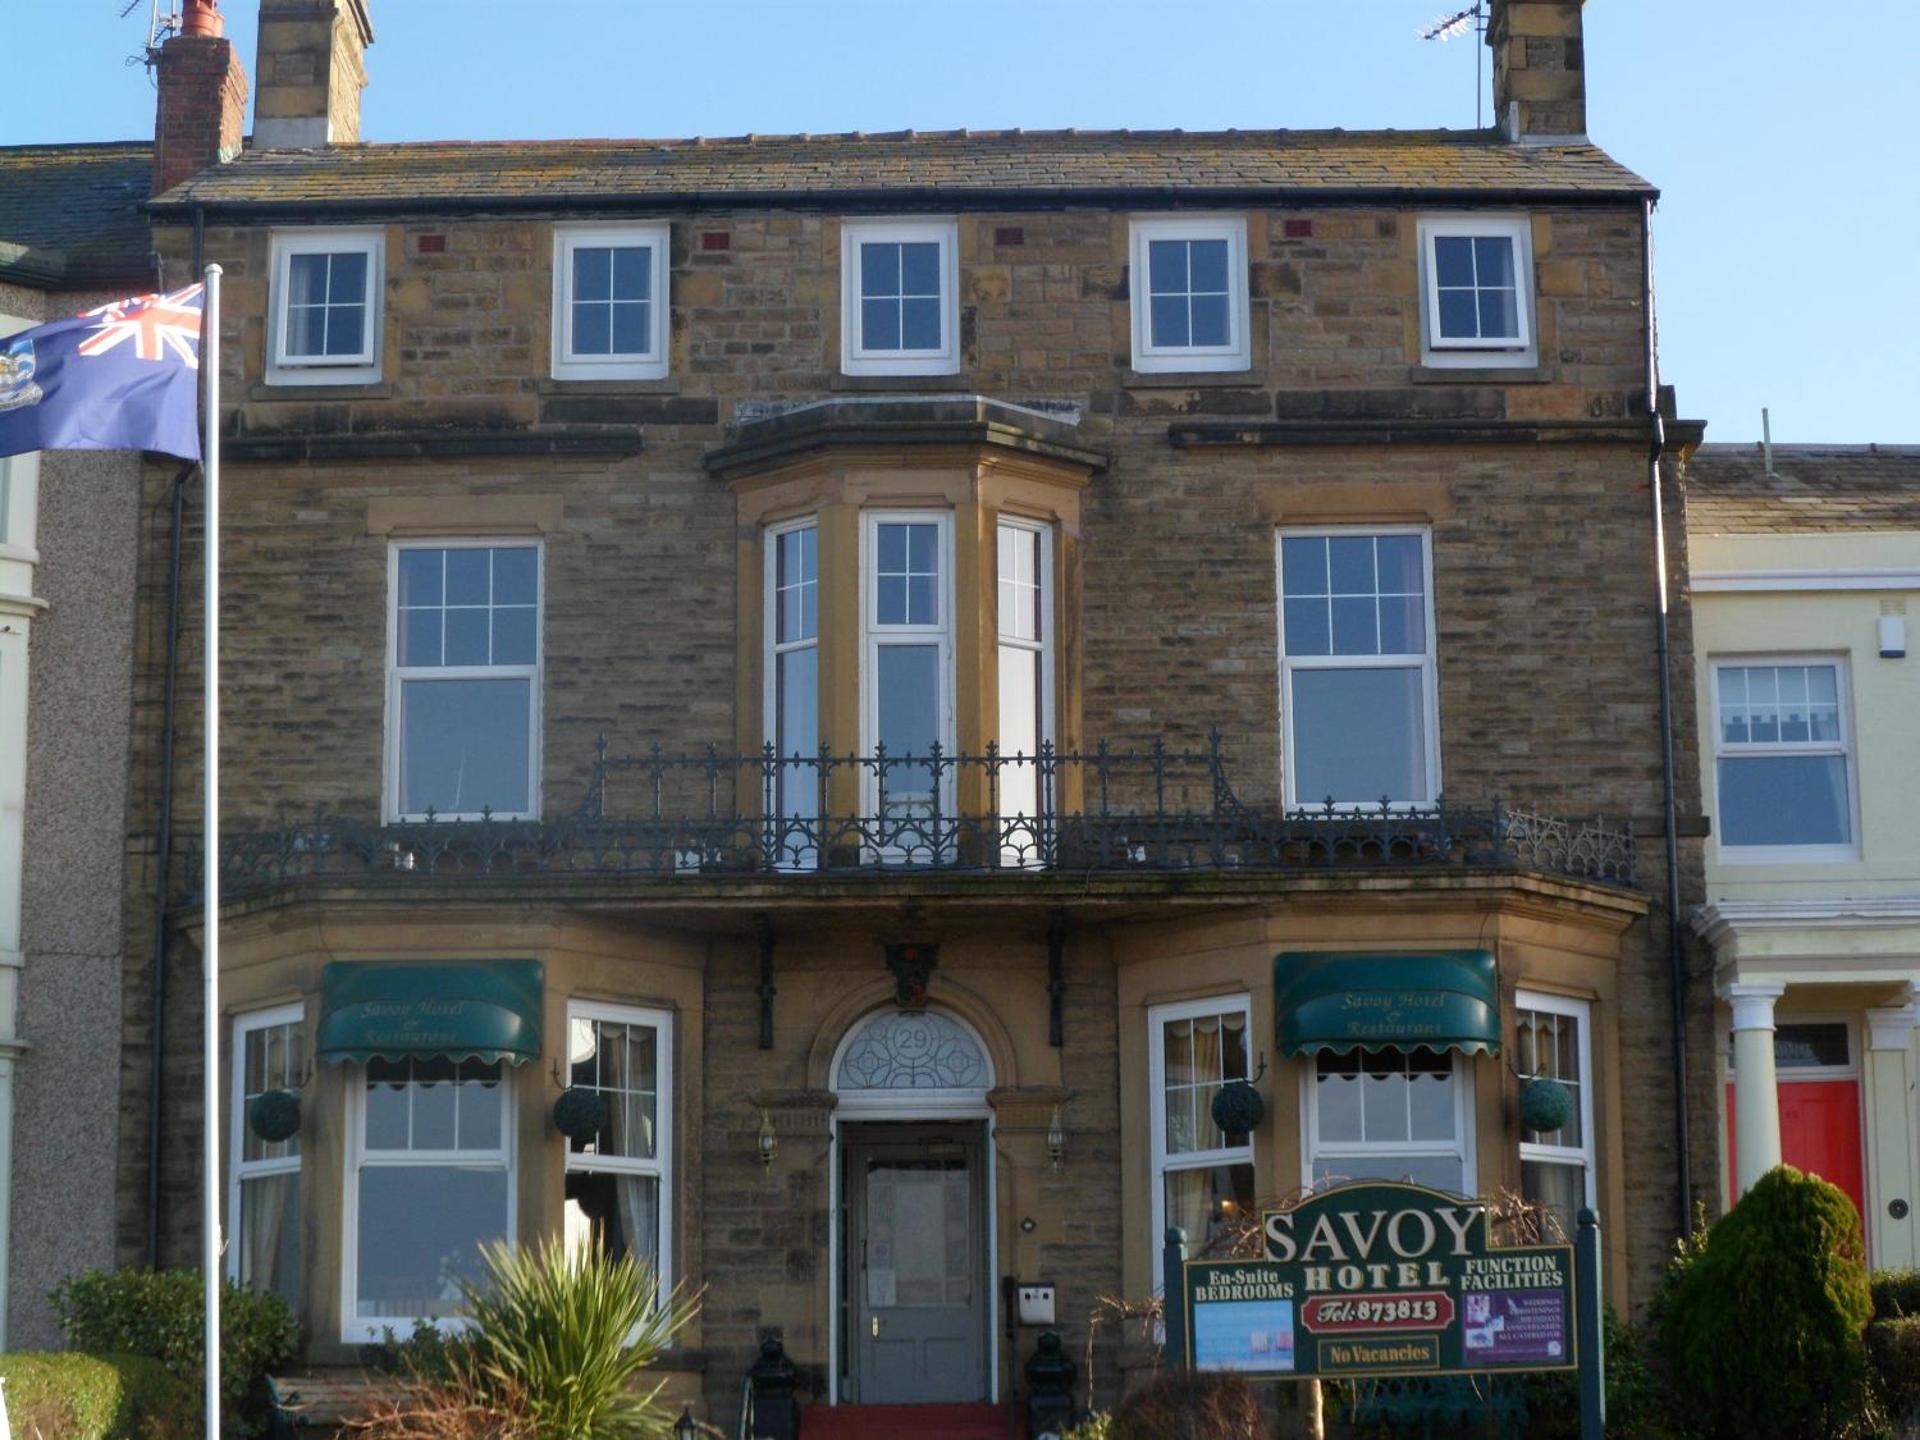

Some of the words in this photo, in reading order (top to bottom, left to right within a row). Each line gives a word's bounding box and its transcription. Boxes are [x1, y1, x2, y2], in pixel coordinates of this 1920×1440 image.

[1398, 991, 1447, 1007] Hotel
[899, 1029, 927, 1048] 29
[1265, 1207, 1481, 1262] SAVOY
[1465, 1255, 1557, 1274] FUNCTION
[1209, 1268, 1279, 1285] En-Suite
[1304, 1261, 1450, 1291] HOTEL
[1460, 1271, 1564, 1290] FACILITIES
[1195, 1282, 1294, 1301] BEDROOMS
[1356, 1300, 1437, 1323] 873813
[1331, 1345, 1351, 1363] No
[1352, 1344, 1430, 1362] Vacancies
